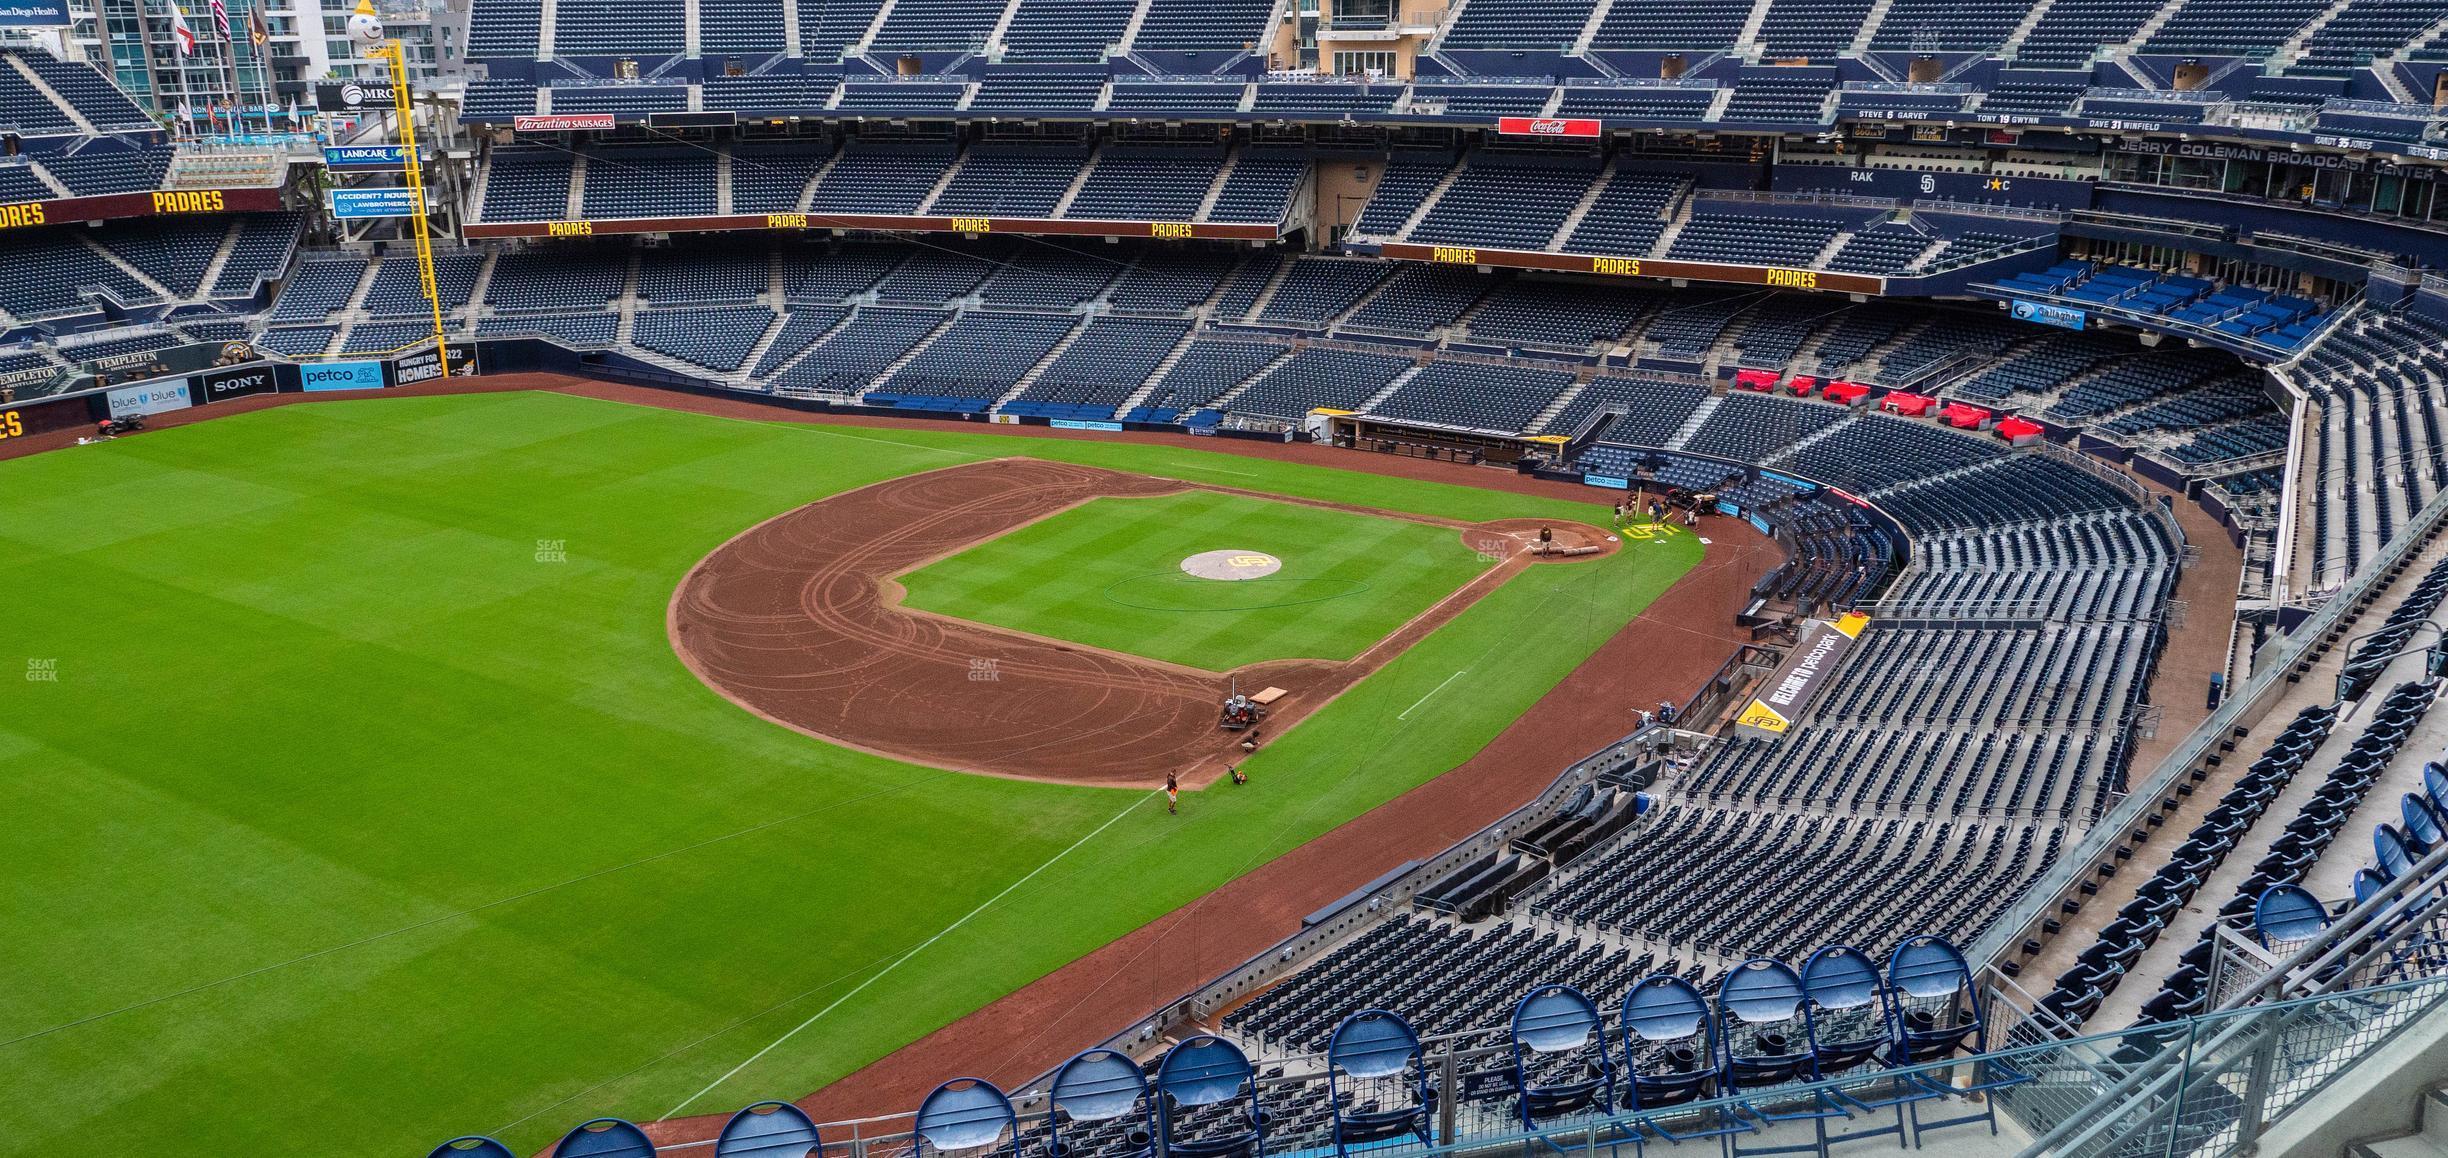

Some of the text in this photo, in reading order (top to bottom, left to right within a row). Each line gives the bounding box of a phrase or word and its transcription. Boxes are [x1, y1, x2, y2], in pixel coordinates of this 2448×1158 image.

[11, 7, 33, 17] Diego
[33, 7, 59, 15] Health
[1859, 110, 1883, 118] STEVE
[1887, 110, 1894, 119] 6
[1977, 114, 2040, 124] TONY 19 GWYNN
[518, 118, 613, 129] Tarantino SAUSAGES
[2089, 119, 2160, 131] DAVE 31 WINFIELD
[2314, 136, 2373, 150] RANDY 35 JONES
[341, 149, 388, 159] LANDCARE
[2119, 140, 2435, 180] JERRY COLEMAN BROADCAST CENTER
[1851, 171, 1873, 182] RAK
[152, 190, 225, 213] PADRES
[767, 214, 807, 228] PADRES
[952, 218, 990, 232] PADRES
[549, 221, 592, 236] PADRES
[1152, 223, 1192, 237] PADRES
[1433, 247, 1475, 264] PADRES
[1593, 257, 1640, 275] PADRES
[1767, 268, 1816, 288] PADRES
[2038, 306, 2081, 322] Gallagher
[96, 351, 158, 370] TEMPLETON
[399, 353, 438, 367] HUNGRY FOR
[446, 349, 463, 360] 322
[306, 367, 353, 385] petco
[398, 363, 443, 383] HOMERS
[214, 375, 265, 392] SONY
[151, 389, 176, 401] blue
[112, 396, 137, 409] blue
[1586, 476, 1606, 484] petco
[1769, 674, 1809, 706] WELCOME
[1801, 646, 1826, 670] petco
[1819, 633, 1841, 651] park
[1484, 1075, 1504, 1083] PLEASE
